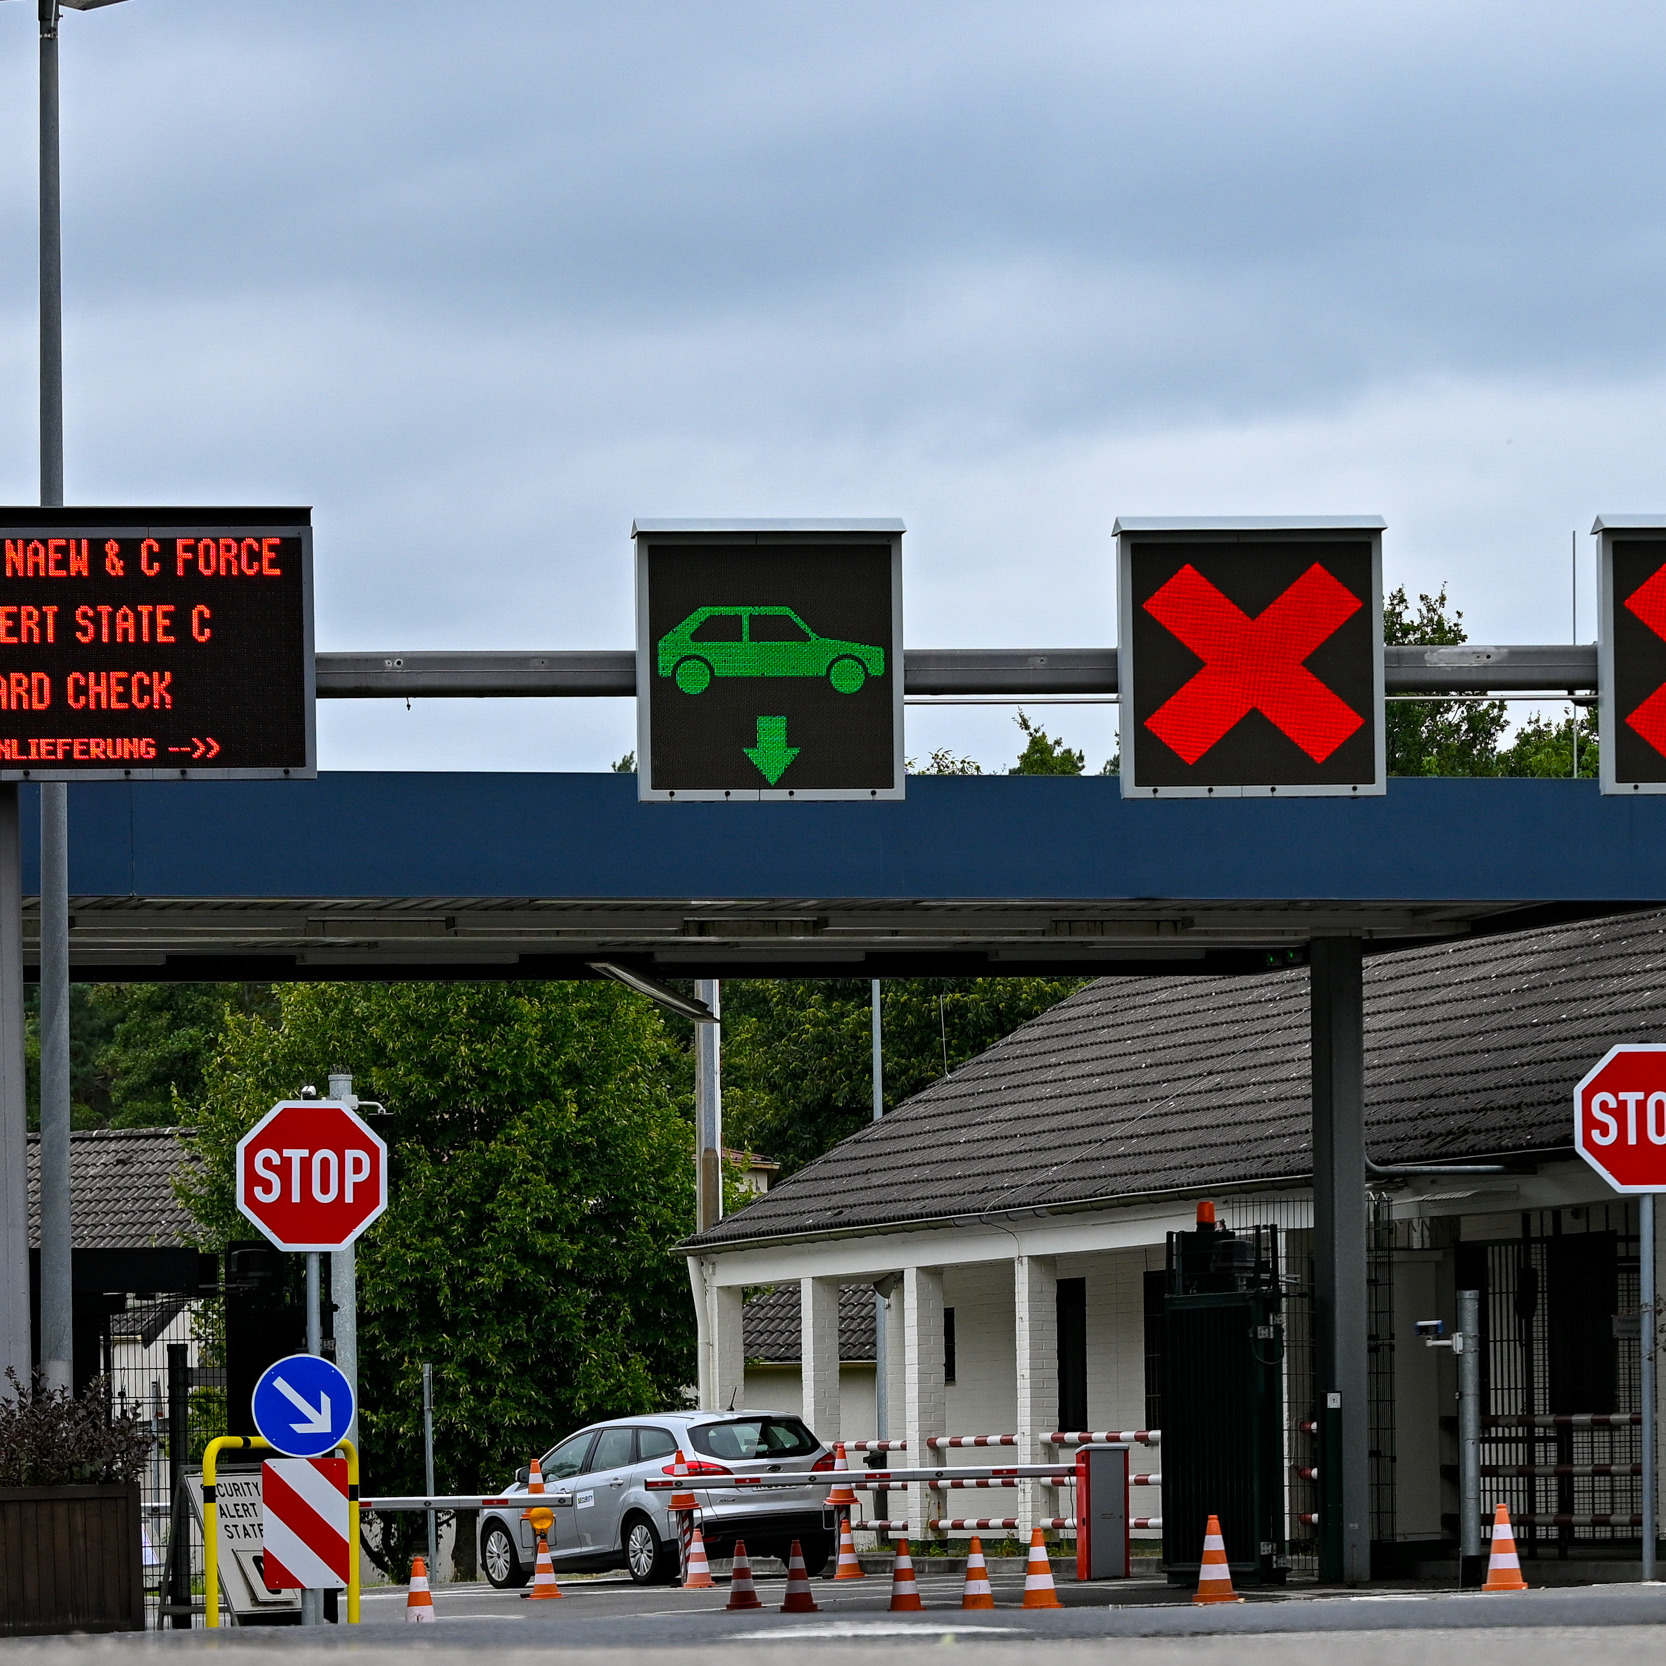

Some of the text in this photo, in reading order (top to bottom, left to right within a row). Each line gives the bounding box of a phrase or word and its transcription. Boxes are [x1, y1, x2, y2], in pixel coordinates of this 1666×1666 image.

[4, 538, 90, 578] NAEW
[104, 538, 125, 577] &
[140, 538, 161, 577] C
[176, 537, 282, 577] FORCE
[75, 604, 176, 644] STATE
[191, 604, 212, 643] C
[66, 671, 172, 710] CHECK
[253, 1147, 372, 1204] STOP
[200, 1481, 262, 1498] CURITY
[218, 1502, 259, 1519] ALERT
